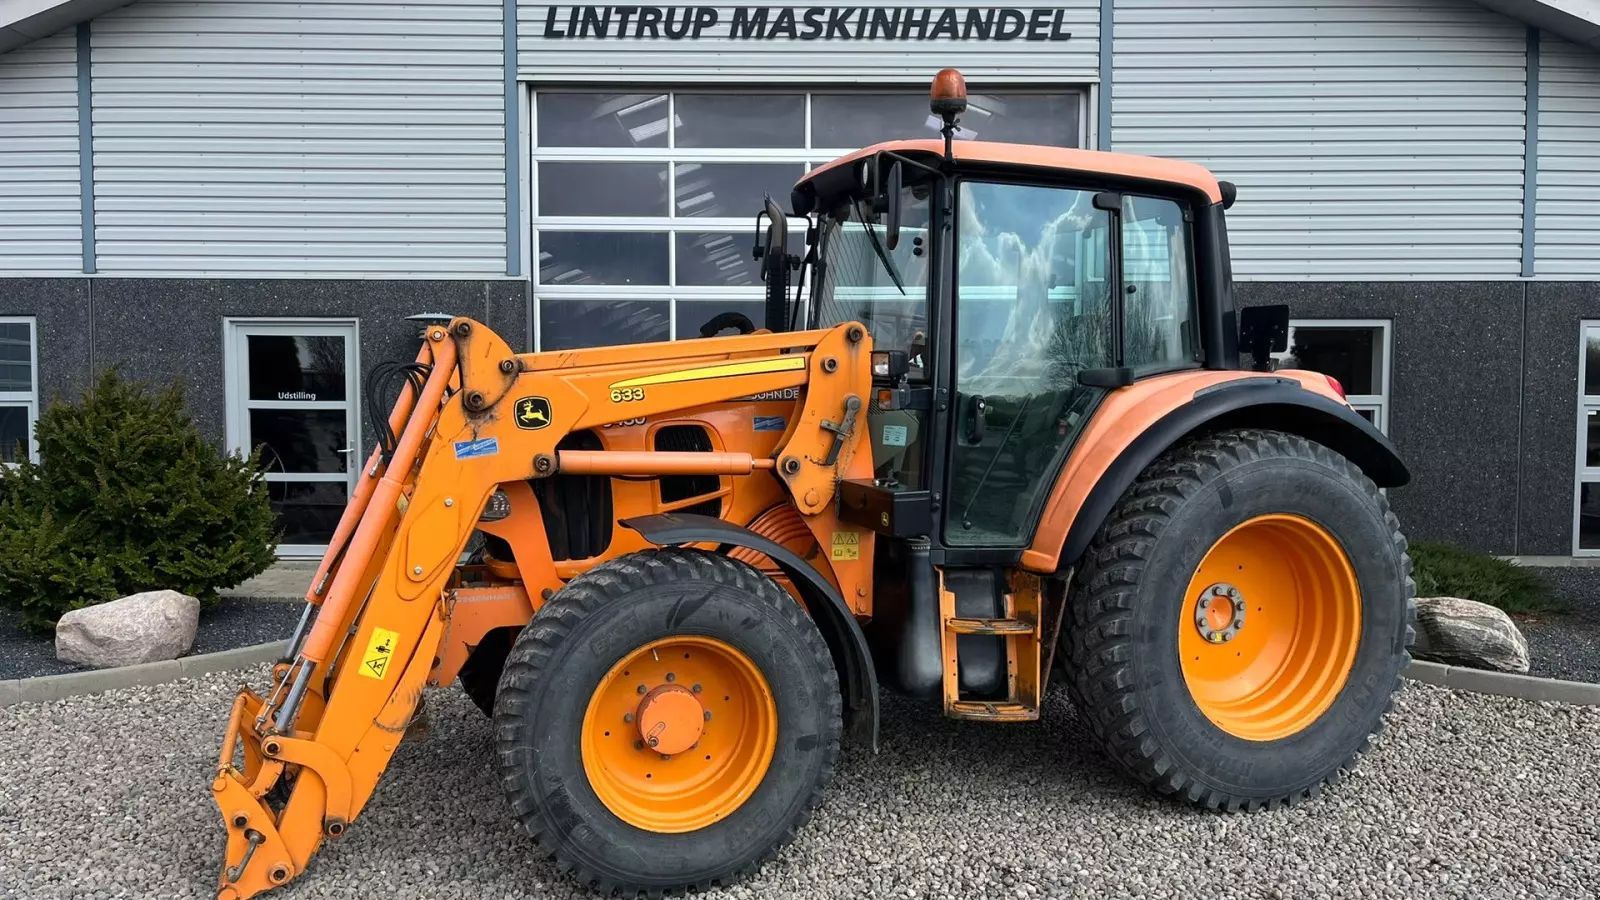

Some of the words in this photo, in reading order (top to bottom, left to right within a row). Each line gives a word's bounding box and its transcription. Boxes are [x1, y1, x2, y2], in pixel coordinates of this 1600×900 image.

[544, 7, 718, 39] LINTRUP
[729, 7, 1072, 41] MASKINHANDEL
[278, 391, 316, 401] Udstilling
[610, 387, 645, 402] 633
